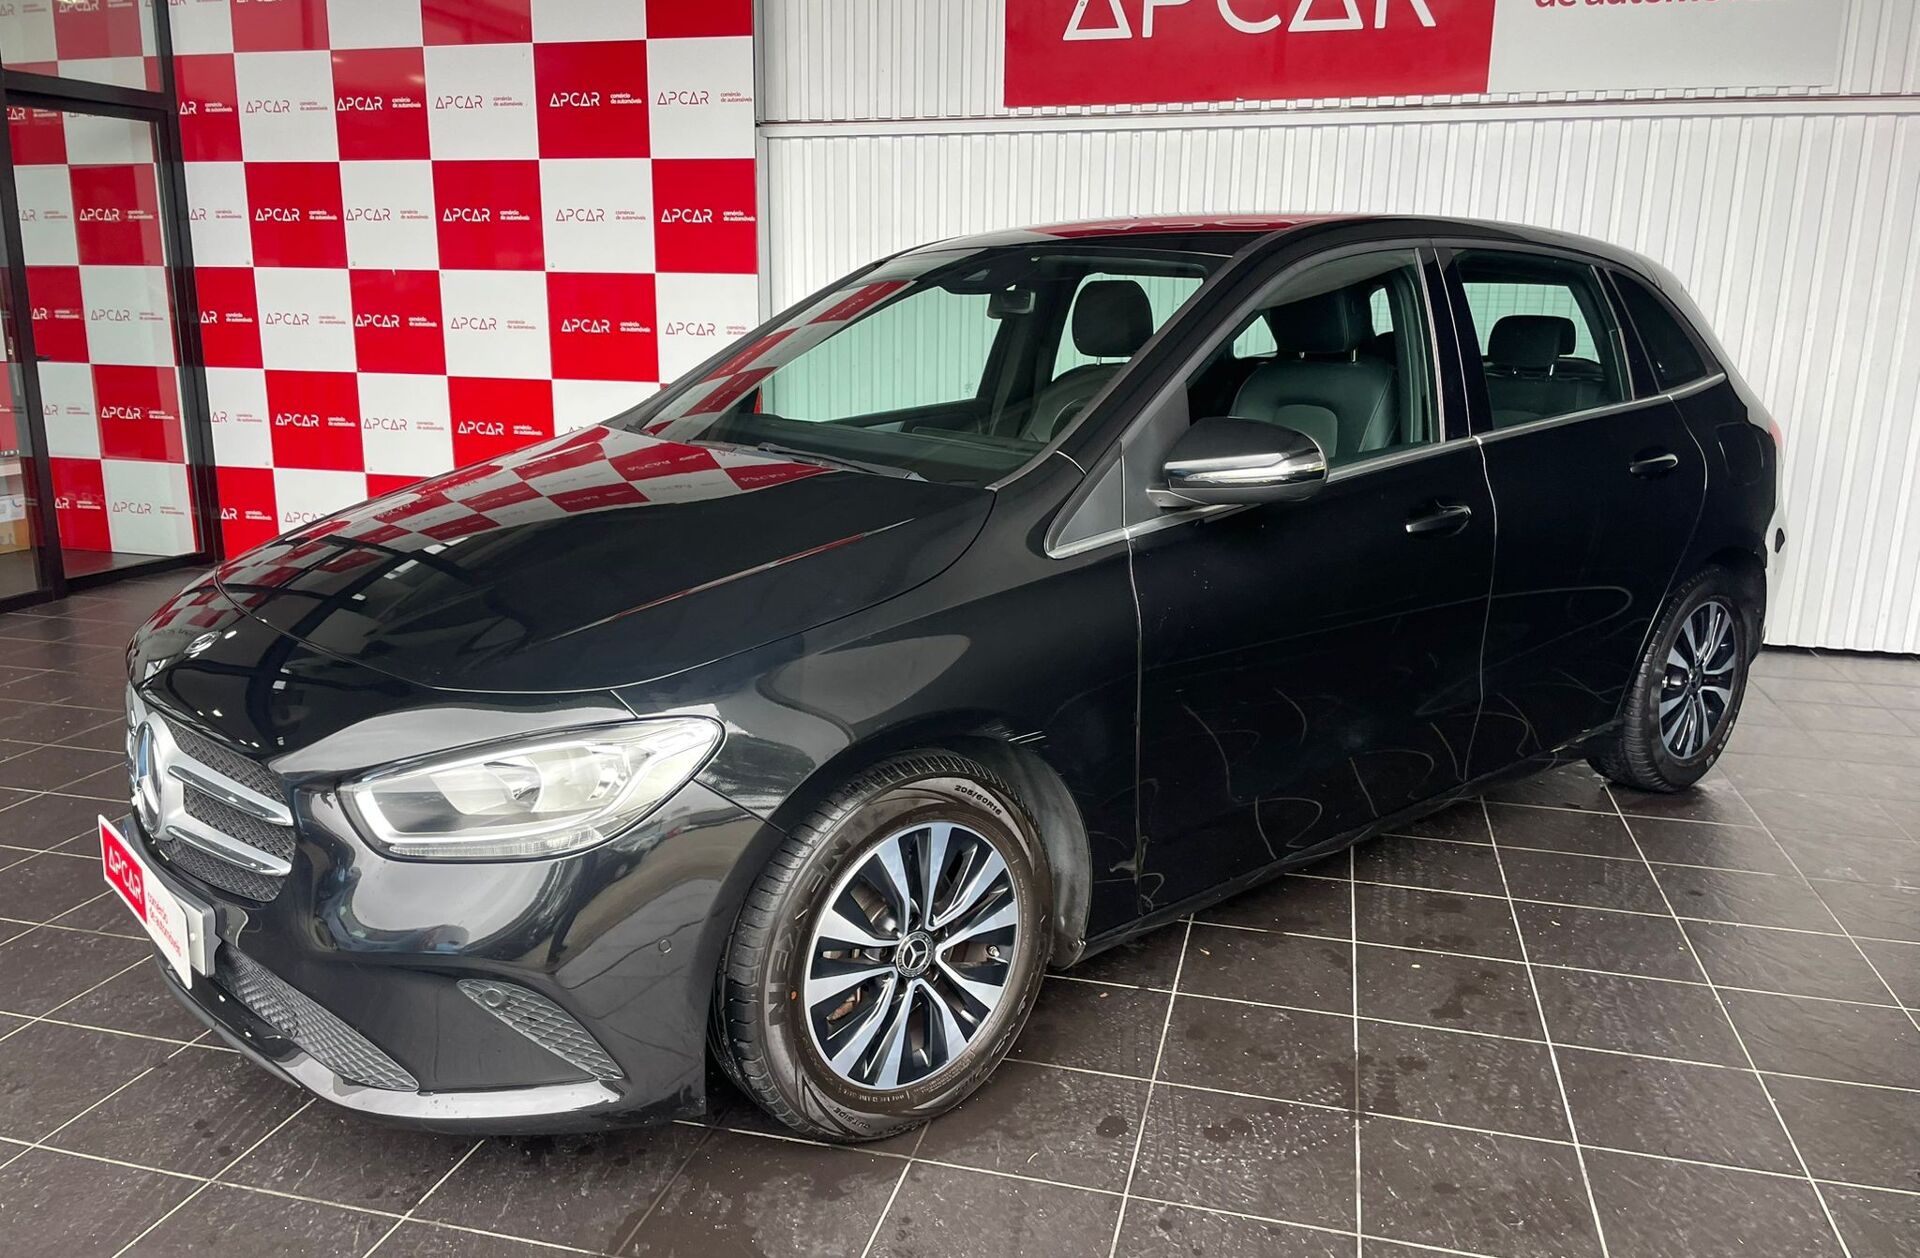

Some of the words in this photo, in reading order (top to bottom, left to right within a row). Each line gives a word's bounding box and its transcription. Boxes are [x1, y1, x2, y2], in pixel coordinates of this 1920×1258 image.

[337, 96, 383, 111] APCAR
[436, 95, 483, 109] APCAR
[550, 92, 600, 107] APCAR
[657, 91, 709, 105] APCAR
[246, 100, 290, 113] APCAR
[80, 208, 120, 221] APCAR
[255, 208, 300, 221] APCAR
[346, 208, 391, 221] APCAR
[443, 208, 490, 222] APCAR
[556, 209, 605, 222] APCAR
[661, 208, 712, 223] APCAR
[91, 309, 131, 321] APCAR
[266, 313, 310, 325] APCAR
[355, 314, 400, 328] APCAR
[451, 317, 497, 330] APCAR
[561, 319, 610, 333] APCAR
[665, 322, 716, 336] APCAR
[101, 406, 142, 420] APCAR
[275, 414, 319, 427] APCAR
[364, 418, 408, 431] APCAR
[458, 421, 504, 435] APCAR
[112, 502, 151, 514] APCAR
[108, 846, 142, 904] APCAR
